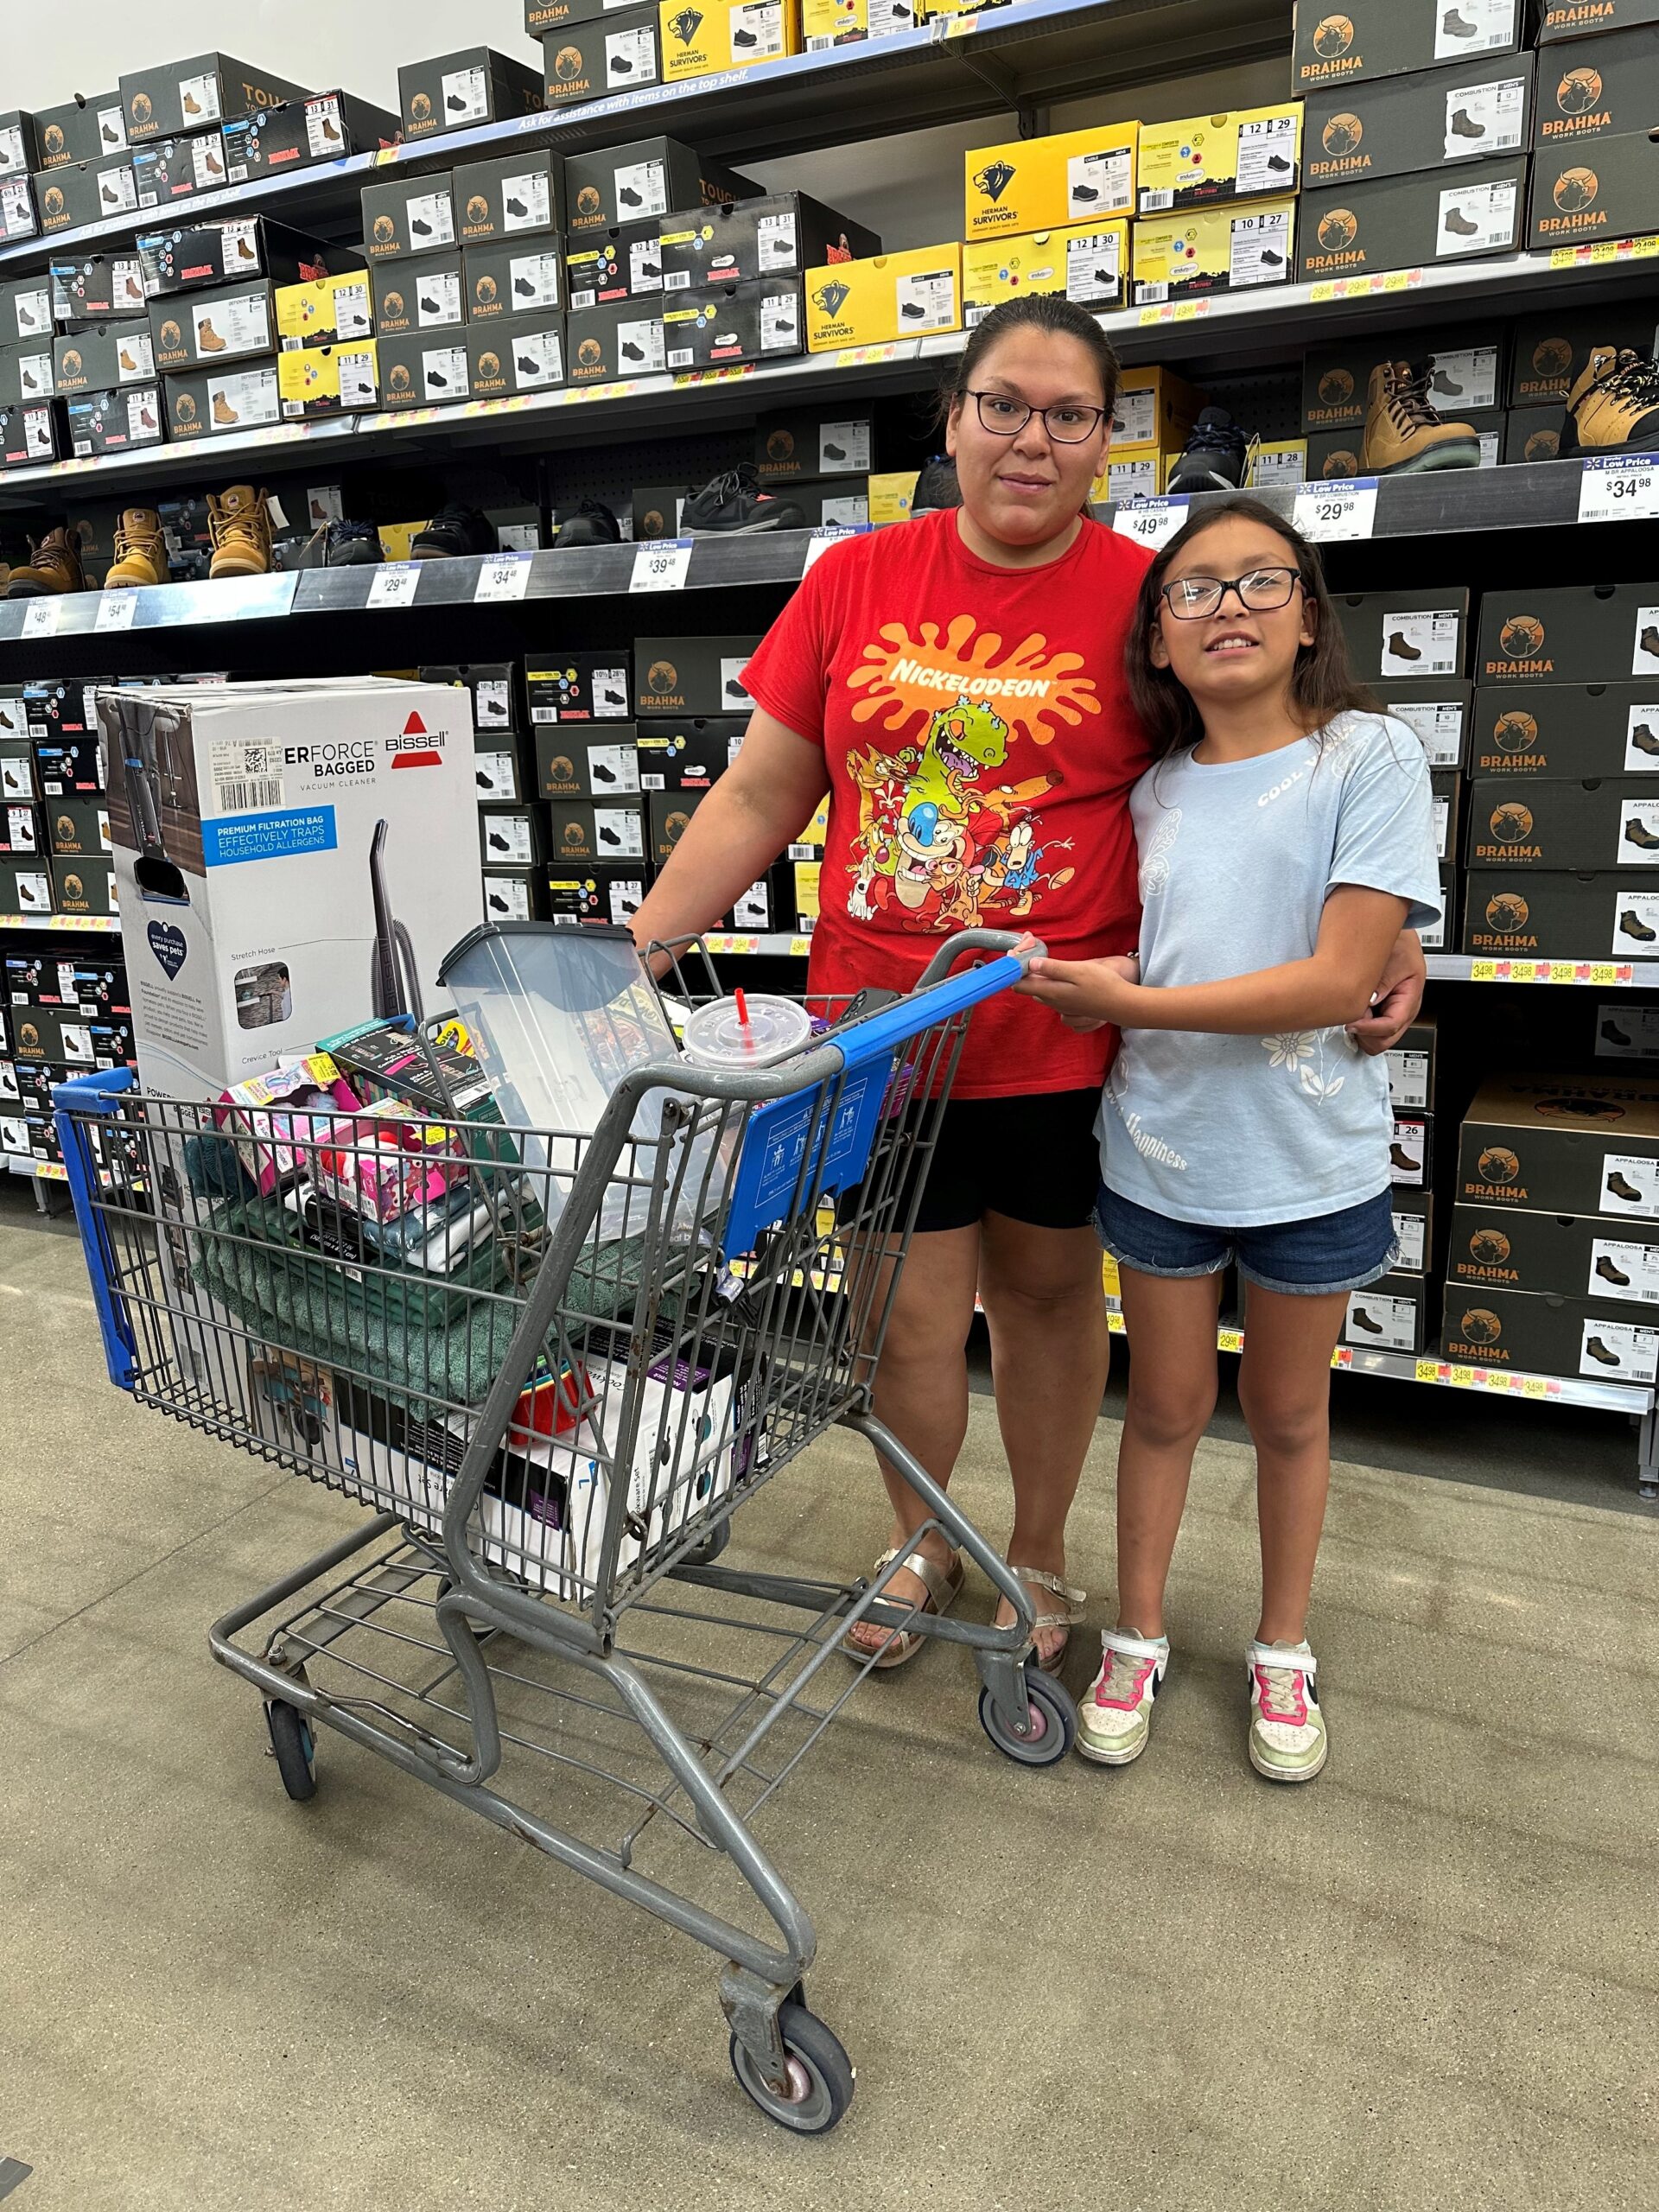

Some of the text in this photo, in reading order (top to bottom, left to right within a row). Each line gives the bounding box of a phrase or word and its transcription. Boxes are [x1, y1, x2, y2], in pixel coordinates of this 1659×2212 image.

[529, 5, 569, 23] BRAHMA
[1546, 3, 1614, 26] BRAHMA
[1554, 17, 1604, 29] WORK BOOTS
[670, 54, 707, 67] SURVIVORS
[1300, 56, 1363, 78] BRAHMA
[1332, 70, 1354, 79] BOOTS
[549, 79, 589, 95] BRAHMA
[1454, 86, 1497, 99] COMBUSTION
[519, 119, 537, 130] Ask
[538, 113, 553, 126] for
[554, 104, 605, 121] assistance
[607, 99, 629, 111] with
[632, 92, 660, 107] items
[664, 90, 676, 99] on
[679, 83, 696, 95] the
[699, 79, 717, 92] top
[719, 70, 748, 85] shelf.
[129, 121, 159, 136] BRAHMA
[408, 118, 437, 132] BRAHMA
[1249, 118, 1290, 134] 12 29
[1542, 112, 1611, 136] BRAHMA
[1553, 130, 1573, 139] WORK
[43, 151, 71, 166] BRAHMA
[1309, 155, 1372, 175] BRAHMA
[1449, 186, 1490, 198] COMBUSTION
[43, 214, 70, 227] BRAHMA
[572, 214, 607, 227] BRAHMA
[782, 214, 791, 223] 31
[973, 212, 1018, 226] SURVIVORS
[1241, 214, 1281, 229] 10 27
[1539, 211, 1608, 232] BRAHMA
[462, 223, 494, 236] BRAHMA
[1548, 228, 1571, 237] WORK
[1077, 234, 1114, 248] 12 30
[370, 242, 400, 254] BRAHMA
[1306, 250, 1366, 270] BRAHMA
[473, 303, 503, 315] BRAHMA
[380, 318, 410, 329] BRAHMA
[813, 327, 855, 340] SURVIVORS
[158, 350, 188, 361] BRAHMA
[572, 365, 607, 376] BRAHMA
[58, 376, 87, 387] BRAHMA
[474, 378, 505, 389] BRAHMA
[1520, 378, 1571, 394] BRAHM
[386, 391, 416, 402] BRAHMA
[1307, 405, 1362, 421] BRAHMA
[174, 422, 202, 434] BRAHMA
[1262, 453, 1298, 464] 11 28
[1603, 458, 1651, 468] Low Price
[1141, 462, 1150, 471] 29
[1606, 478, 1651, 498] $34 98
[1315, 502, 1354, 520] $29 98
[1133, 517, 1168, 534] $49 98
[649, 559, 667, 573] $39
[1486, 660, 1552, 674] BRAHMA
[889, 658, 1051, 697] NICKELODEON
[640, 695, 684, 705] BRAHMA
[284, 741, 374, 765] ERFORCE
[1480, 755, 1547, 767] BRAHMA
[314, 760, 375, 778] BAGGED
[301, 778, 376, 791] VACUUM CLEANER
[546, 782, 581, 791] BRAHMA
[1257, 772, 1303, 807] COOL
[218, 816, 324, 836] PREMIUM FILTRATION BAG
[219, 825, 325, 848] EFFECTIVELY TRAPS
[55, 842, 82, 850] BRAHMA
[219, 836, 325, 857] HOUSEHOLD ALLERGENS
[1476, 845, 1542, 857] BRAHMA
[62, 900, 89, 910] BRAHMA
[1472, 934, 1538, 947] BRAHMA
[169, 946, 184, 956] pets
[231, 946, 276, 962] Stretch Hose
[18, 1046, 45, 1056] BRAHMA
[242, 1048, 283, 1065] Crevice Tool
[1406, 1126, 1418, 1135] 26
[1465, 1183, 1529, 1199] BRAHMA
[1457, 1262, 1519, 1281] BRAHMA
[1594, 1323, 1632, 1332] APPALOOSA
[1449, 1343, 1510, 1360] BRAHMA
